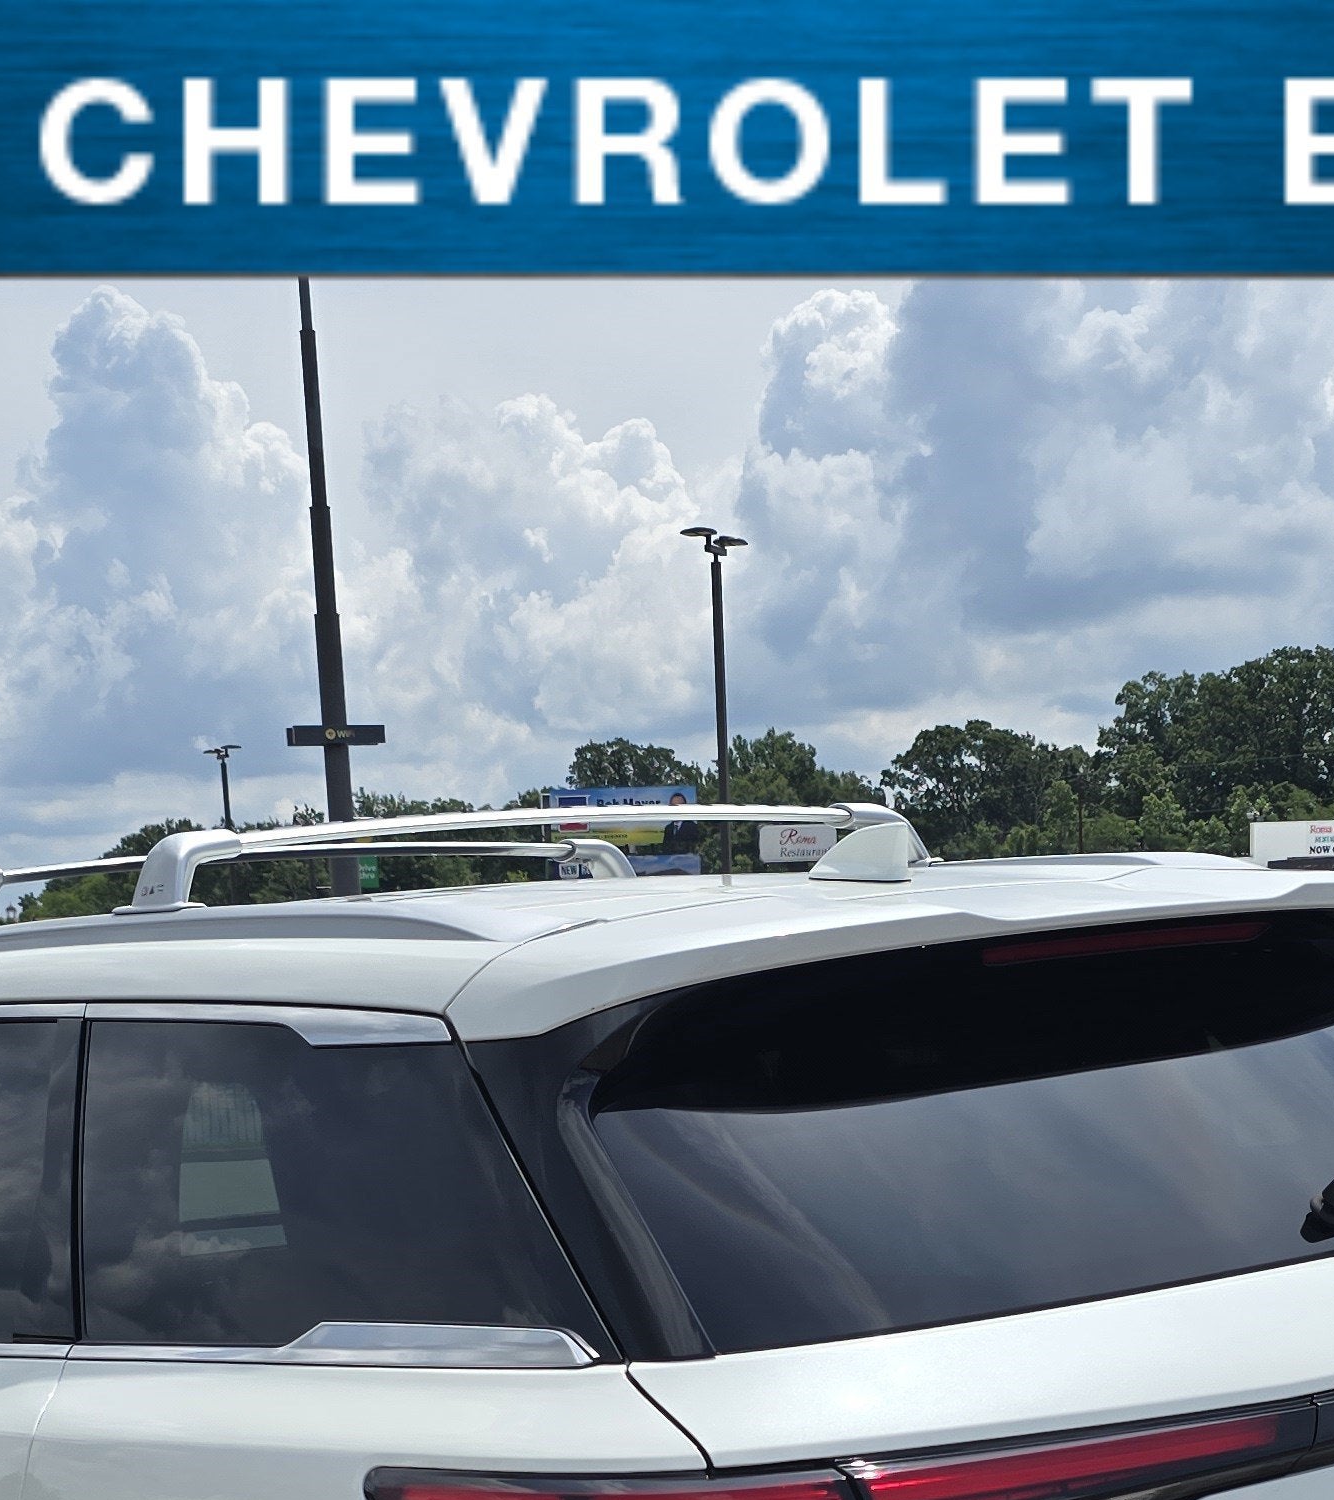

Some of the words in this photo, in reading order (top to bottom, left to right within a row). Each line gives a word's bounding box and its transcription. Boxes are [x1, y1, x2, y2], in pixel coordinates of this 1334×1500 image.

[1310, 825, 1332, 834] Roma
[779, 828, 817, 845] Roma
[1309, 846, 1331, 854] NOW
[561, 865, 578, 876] NEW
